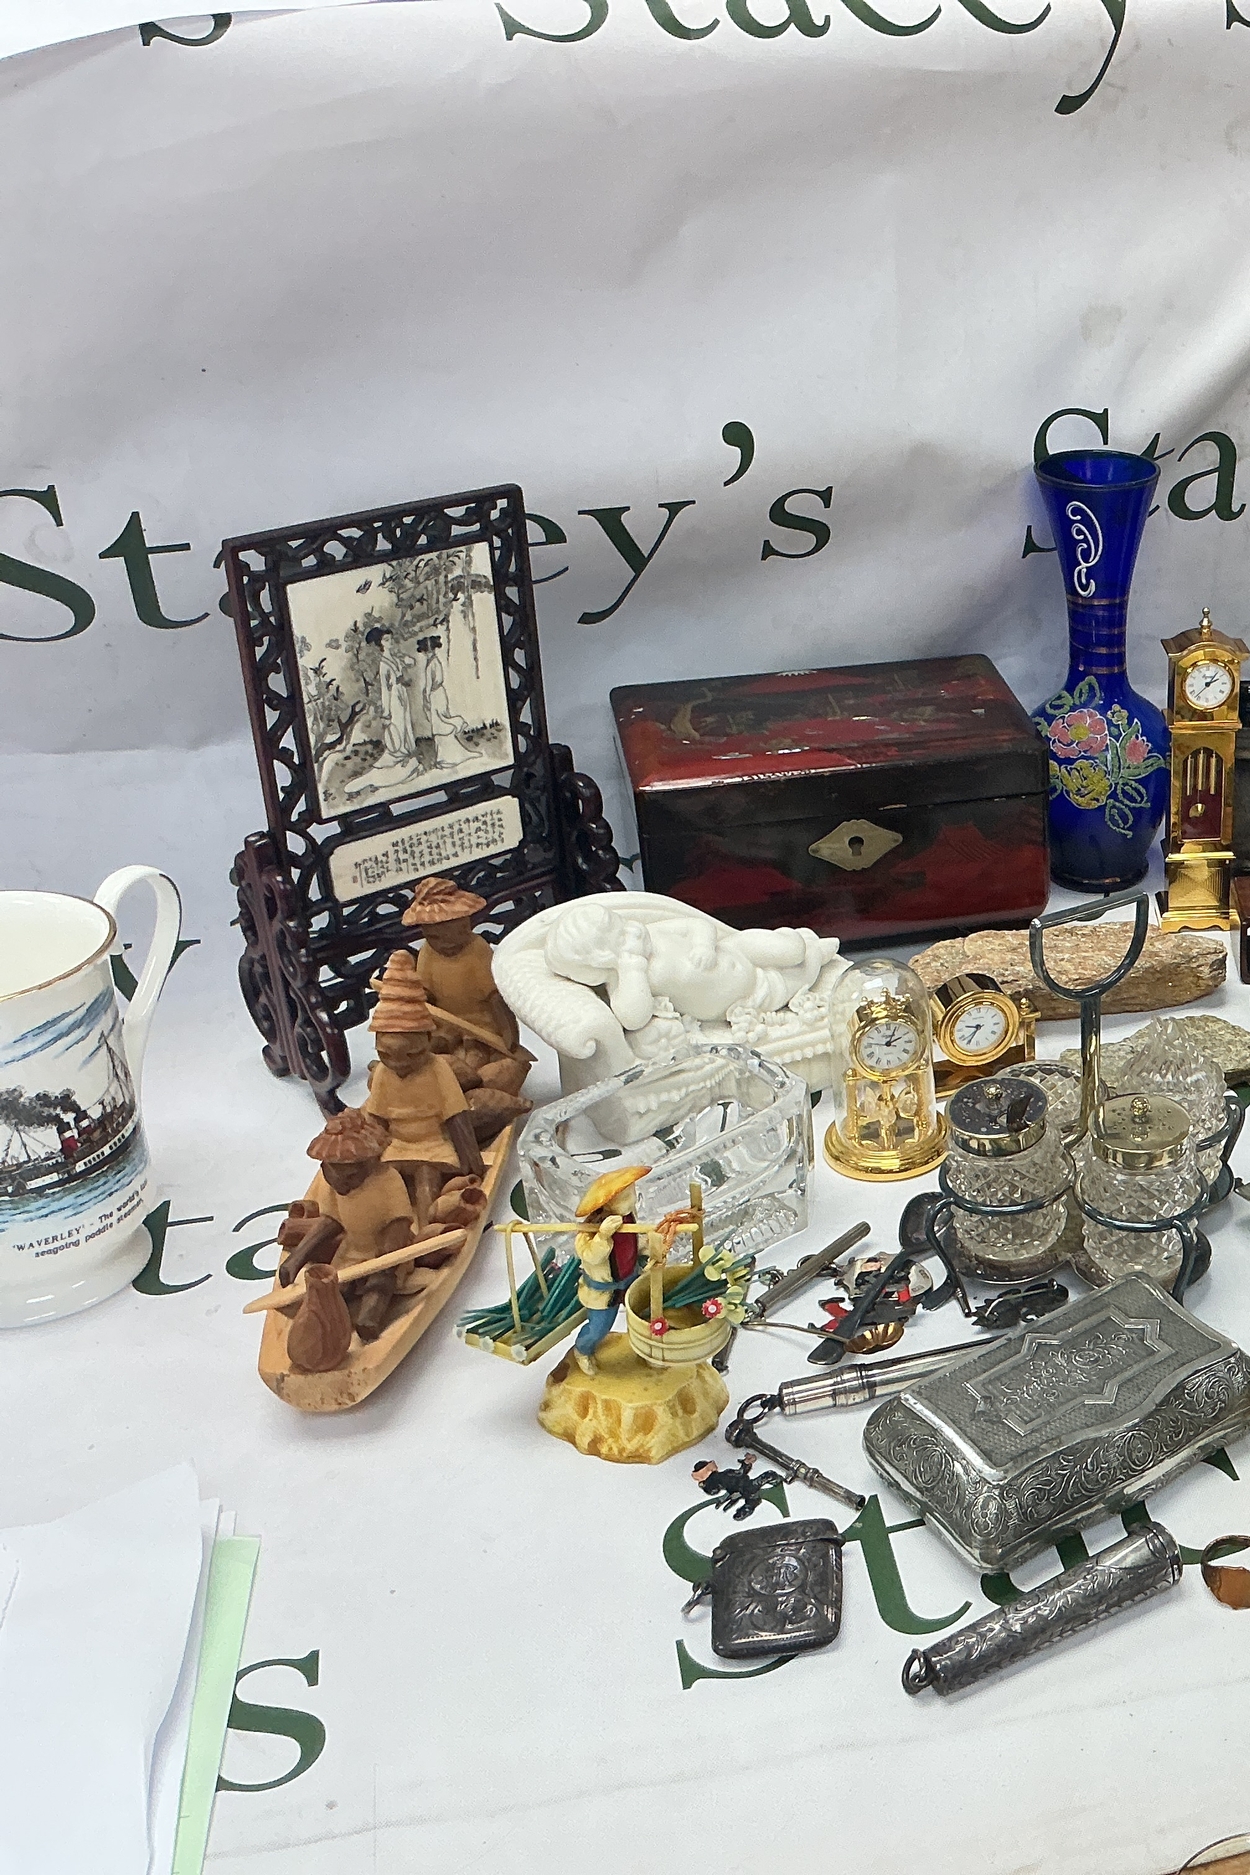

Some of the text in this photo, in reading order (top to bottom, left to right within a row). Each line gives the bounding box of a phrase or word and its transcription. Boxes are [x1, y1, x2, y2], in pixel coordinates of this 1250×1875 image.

[98, 1211, 114, 1224] The
[34, 1239, 81, 1258] seagoing
[84, 1222, 114, 1243] paddle
